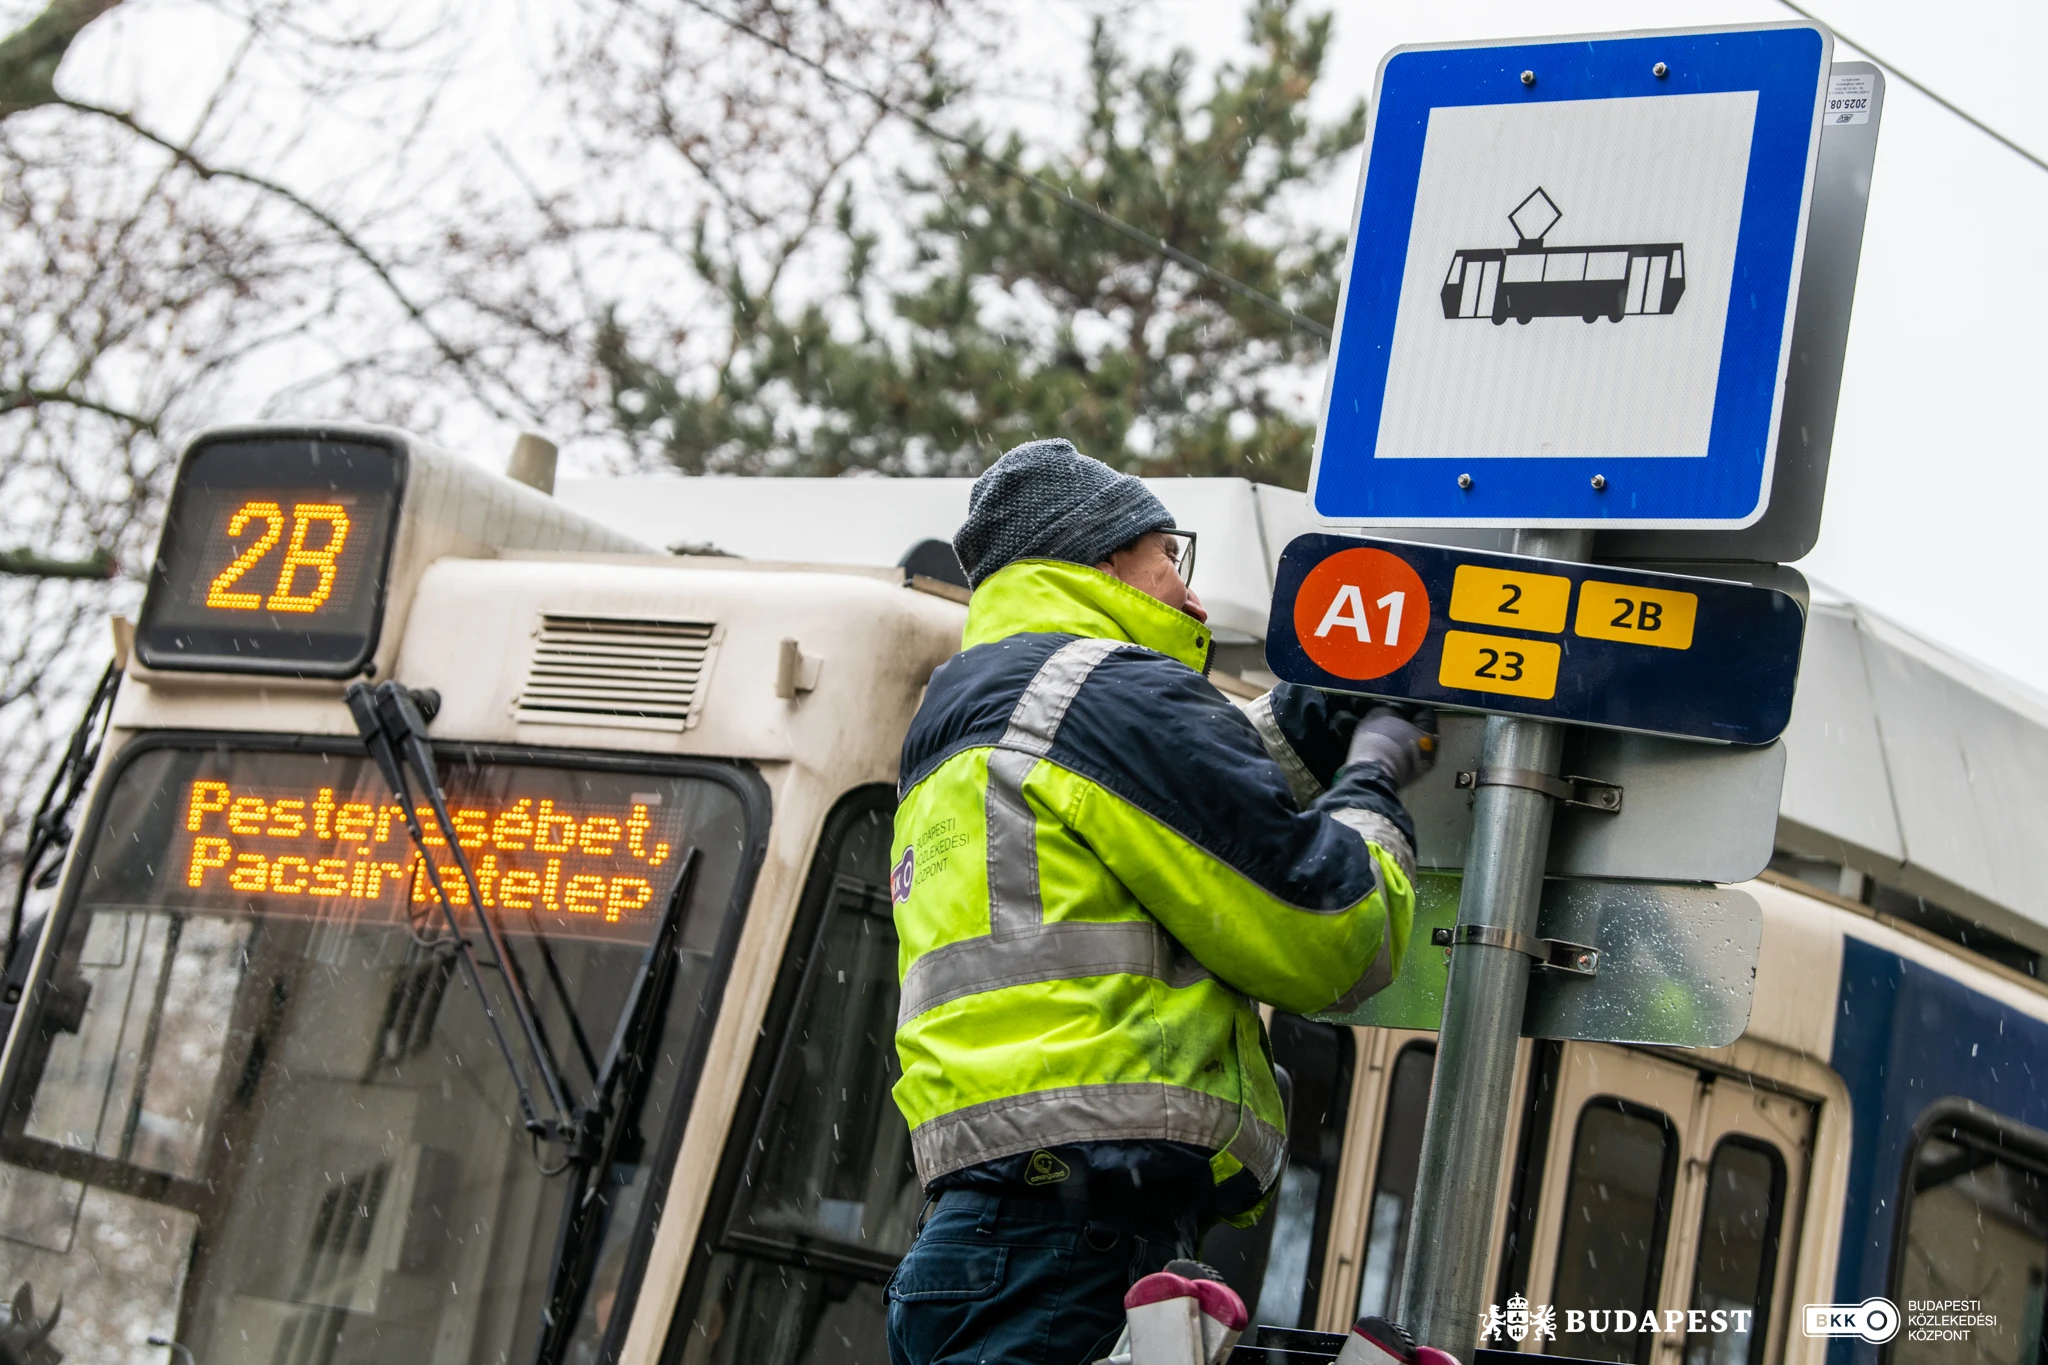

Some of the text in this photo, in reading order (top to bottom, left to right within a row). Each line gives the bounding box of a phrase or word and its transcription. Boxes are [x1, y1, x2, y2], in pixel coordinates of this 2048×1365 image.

[1828, 98, 1868, 109] 2025.08.
[206, 502, 350, 612] 2B
[1314, 584, 1406, 647] A1
[1497, 584, 1663, 633] 2 2B
[1474, 648, 1526, 682] 23
